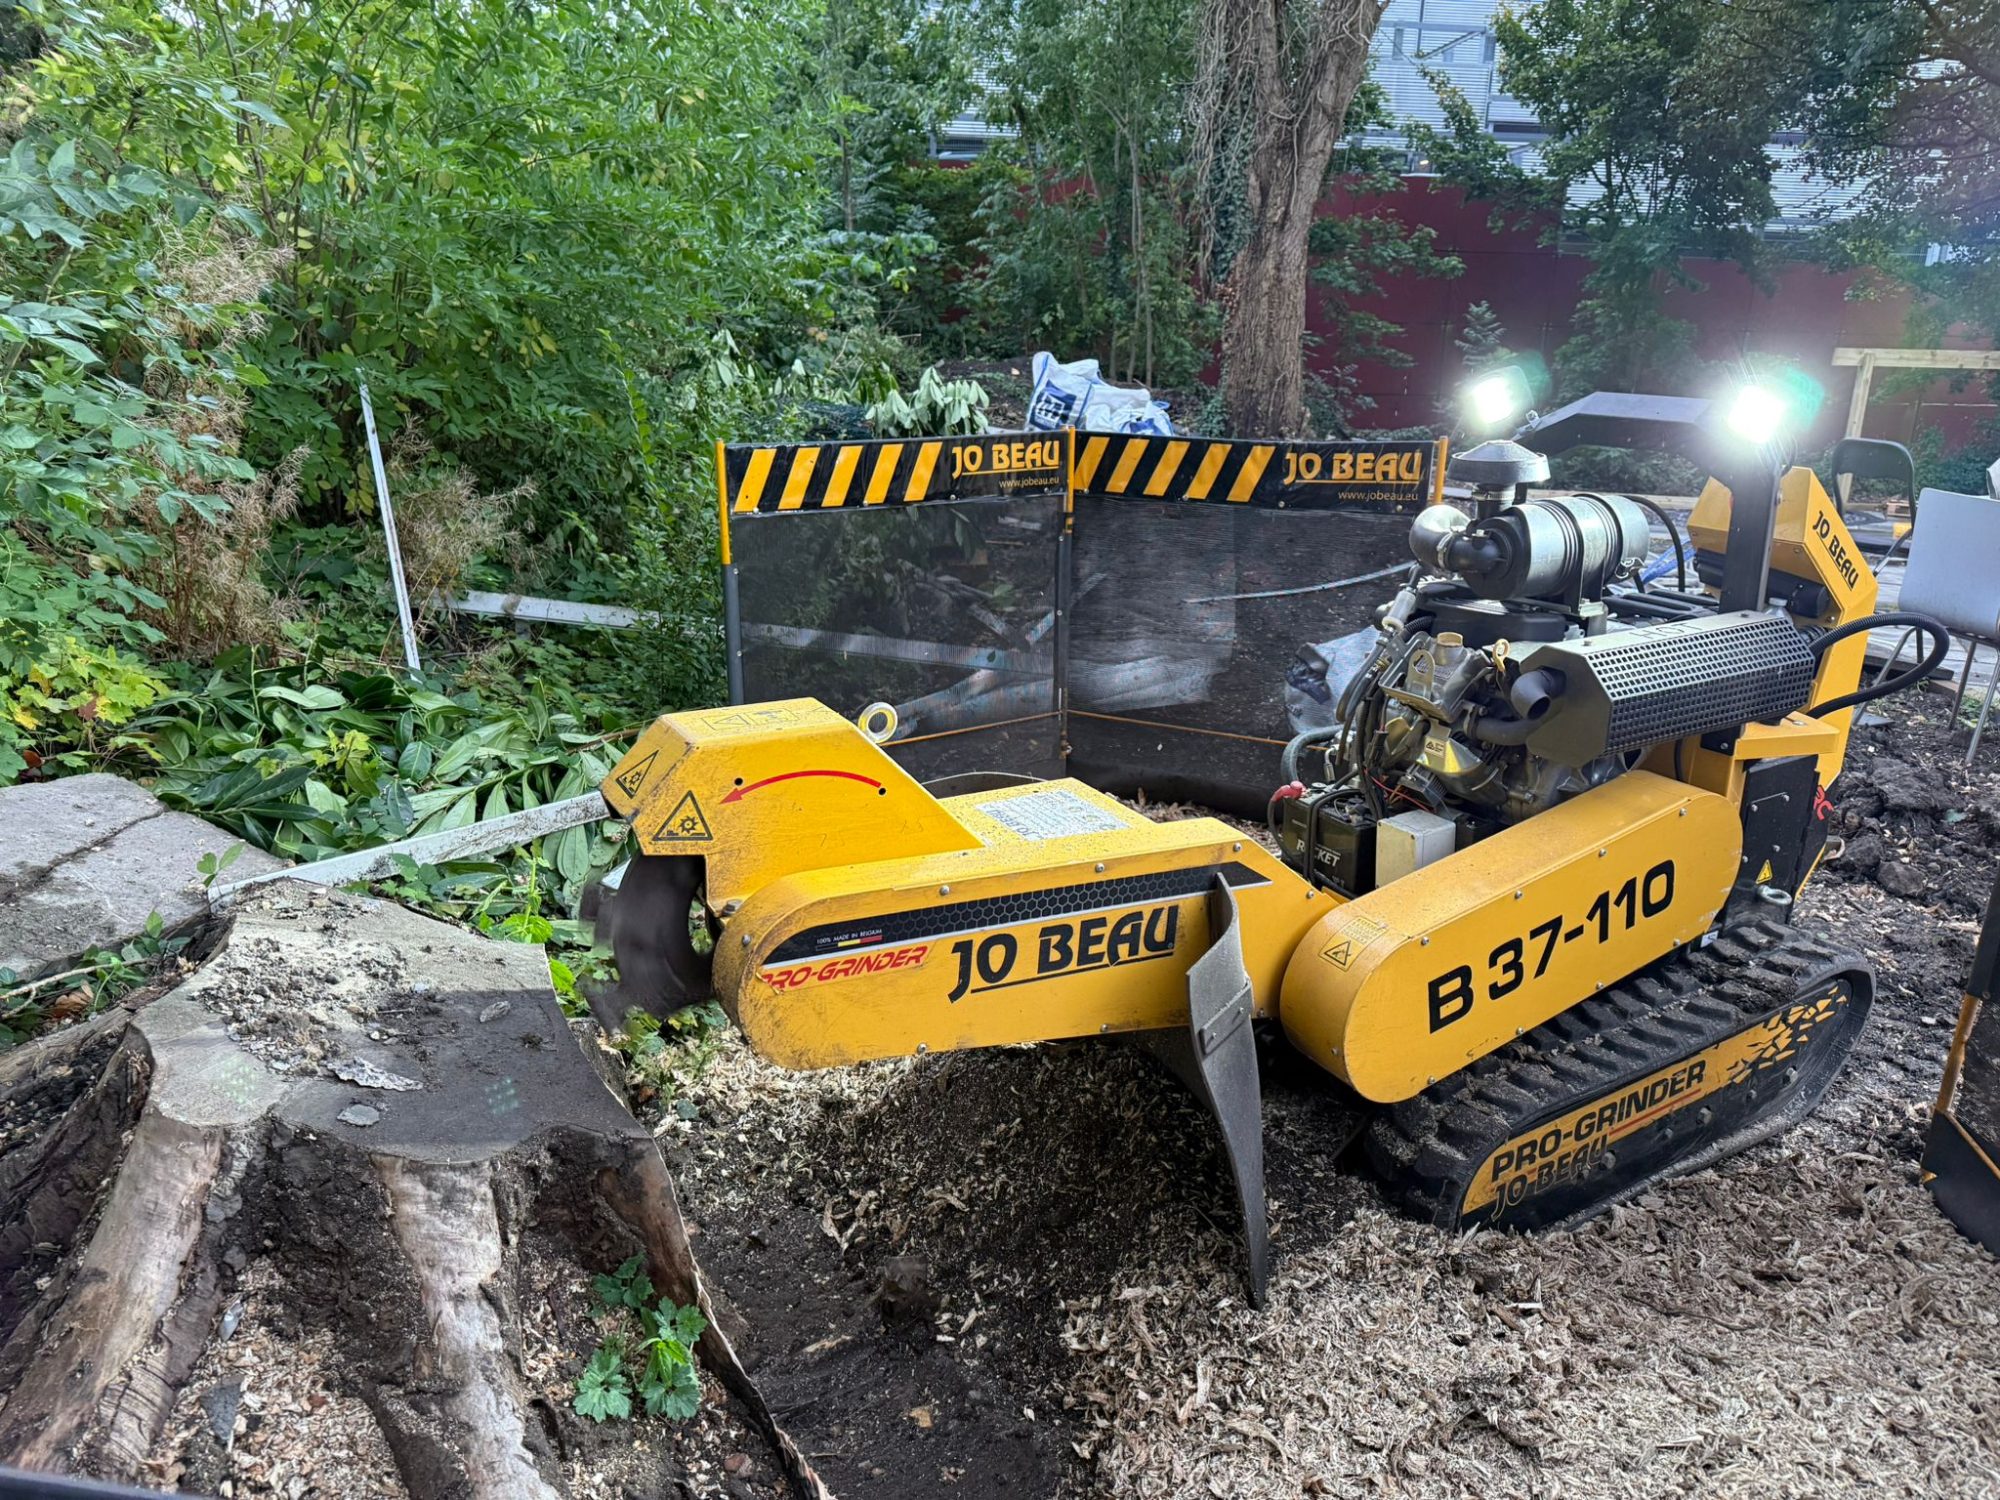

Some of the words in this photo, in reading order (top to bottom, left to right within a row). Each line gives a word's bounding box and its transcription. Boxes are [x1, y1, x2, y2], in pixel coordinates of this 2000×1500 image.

[952, 445, 983, 479] JO
[992, 440, 1060, 469] BEAU
[1284, 453, 1322, 485] JO
[1332, 452, 1422, 484] BEAU
[999, 476, 1059, 490] www.jobeau.eu
[1337, 490, 1418, 502] www.jobeau.eu
[1812, 510, 1830, 539] JO
[1828, 534, 1859, 590] BEAU
[1629, 622, 1702, 639] HOT
[833, 933, 850, 942] MADE
[947, 933, 1018, 1004] JO
[1036, 905, 1179, 975] BEAU
[1428, 964, 1474, 1034] B
[1488, 859, 1675, 1001] 37-110
[1491, 1059, 1707, 1183] PRO-GRINDER
[1491, 1174, 1528, 1222] JO
[1535, 1133, 1608, 1194] BEAU
